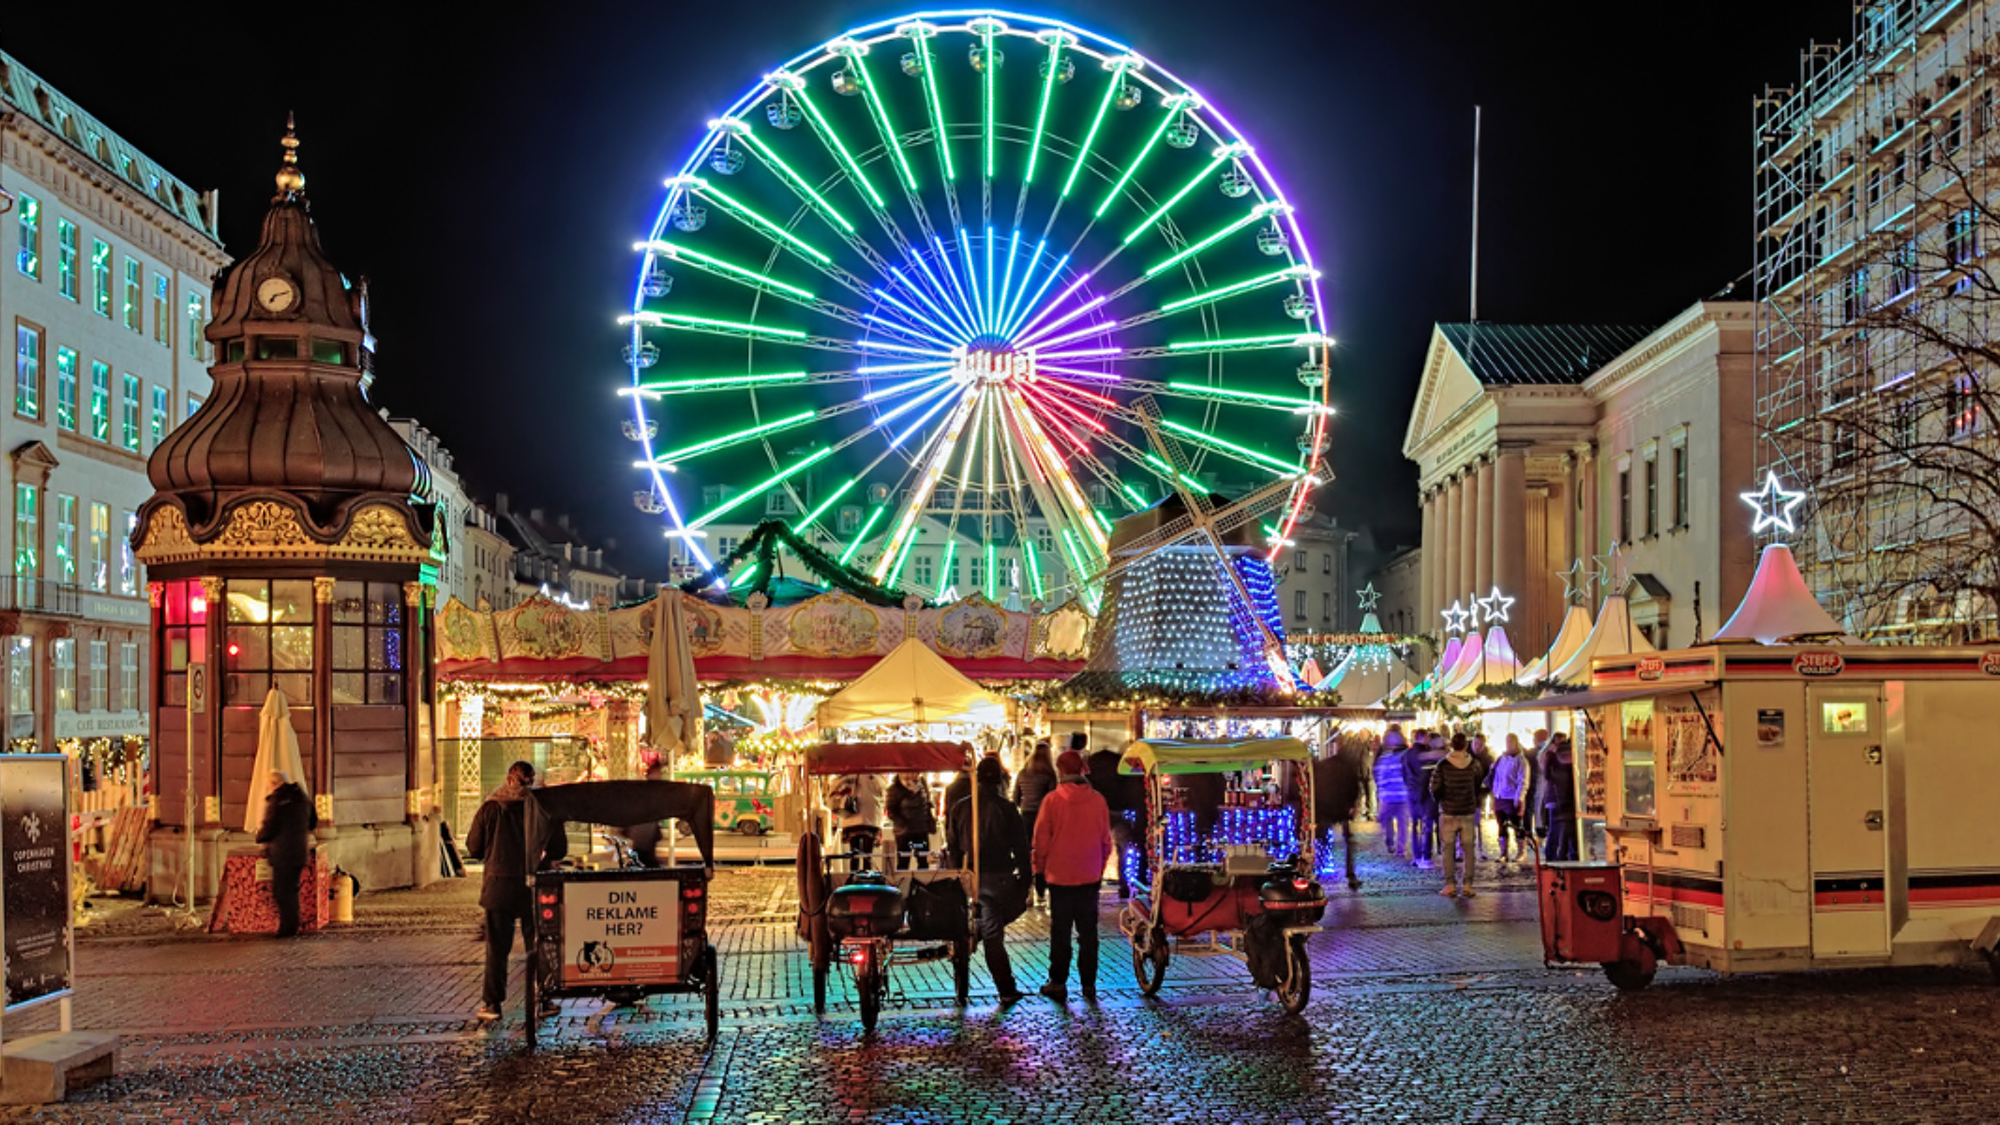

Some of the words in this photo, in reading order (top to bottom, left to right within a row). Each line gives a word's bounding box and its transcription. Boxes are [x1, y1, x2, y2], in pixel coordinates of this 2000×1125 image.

[1800, 653, 1837, 666] STEFF
[13, 847, 55, 861] COPENHAGEN
[17, 859, 52, 873] CHRISTMAS
[608, 891, 637, 904] DIN
[586, 906, 658, 920] REKLAME
[605, 922, 643, 936] HER?
